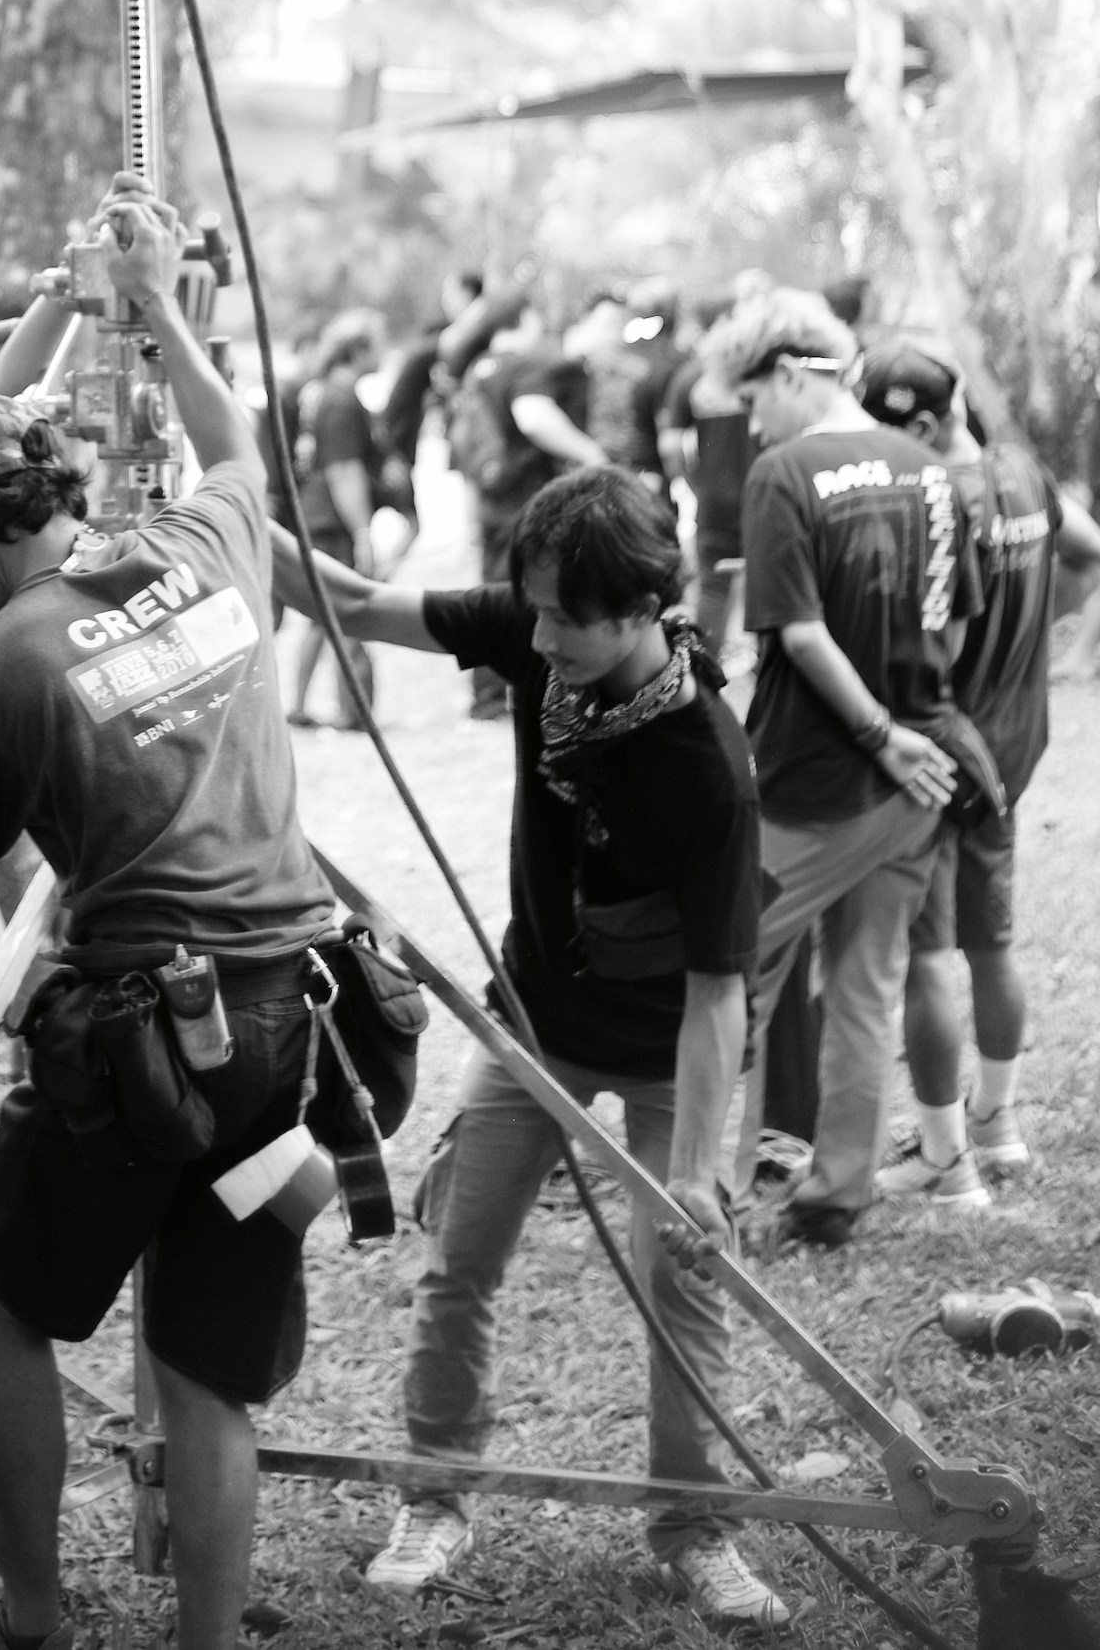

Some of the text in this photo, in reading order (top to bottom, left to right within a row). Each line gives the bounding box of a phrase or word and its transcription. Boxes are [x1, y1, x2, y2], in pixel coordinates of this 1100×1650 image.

[67, 562, 200, 649] CREW
[103, 652, 150, 680] JAVA
[156, 650, 197, 680] 2010
